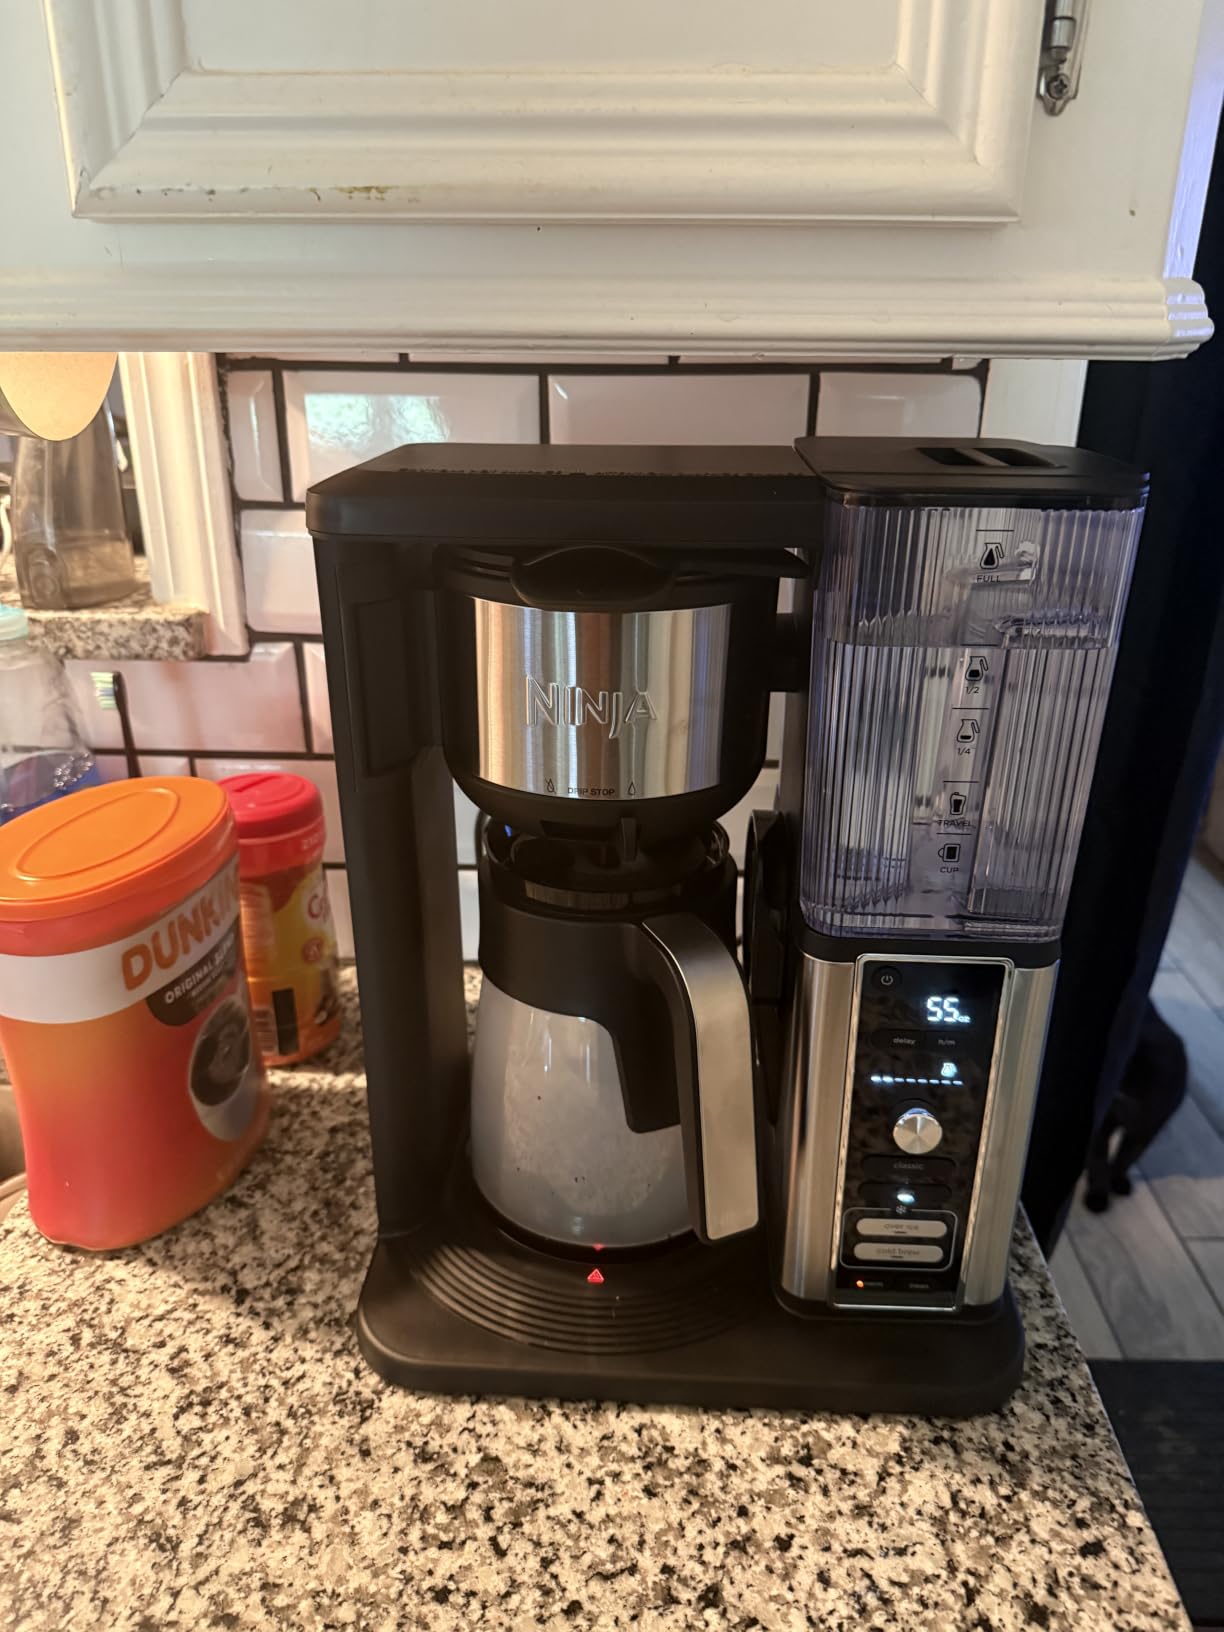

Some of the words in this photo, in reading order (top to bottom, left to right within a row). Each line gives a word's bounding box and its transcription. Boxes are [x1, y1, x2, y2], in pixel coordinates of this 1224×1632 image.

[976, 574, 1001, 583] FULL
[965, 685, 981, 695] 1/2
[525, 674, 658, 739] NINJA
[956, 746, 971, 755] 1/4
[567, 786, 589, 796] DRIP
[590, 787, 615, 796] STOP
[939, 865, 960, 874] CUP
[164, 959, 214, 1004] ORIGINAL
[926, 996, 960, 1023] 55
